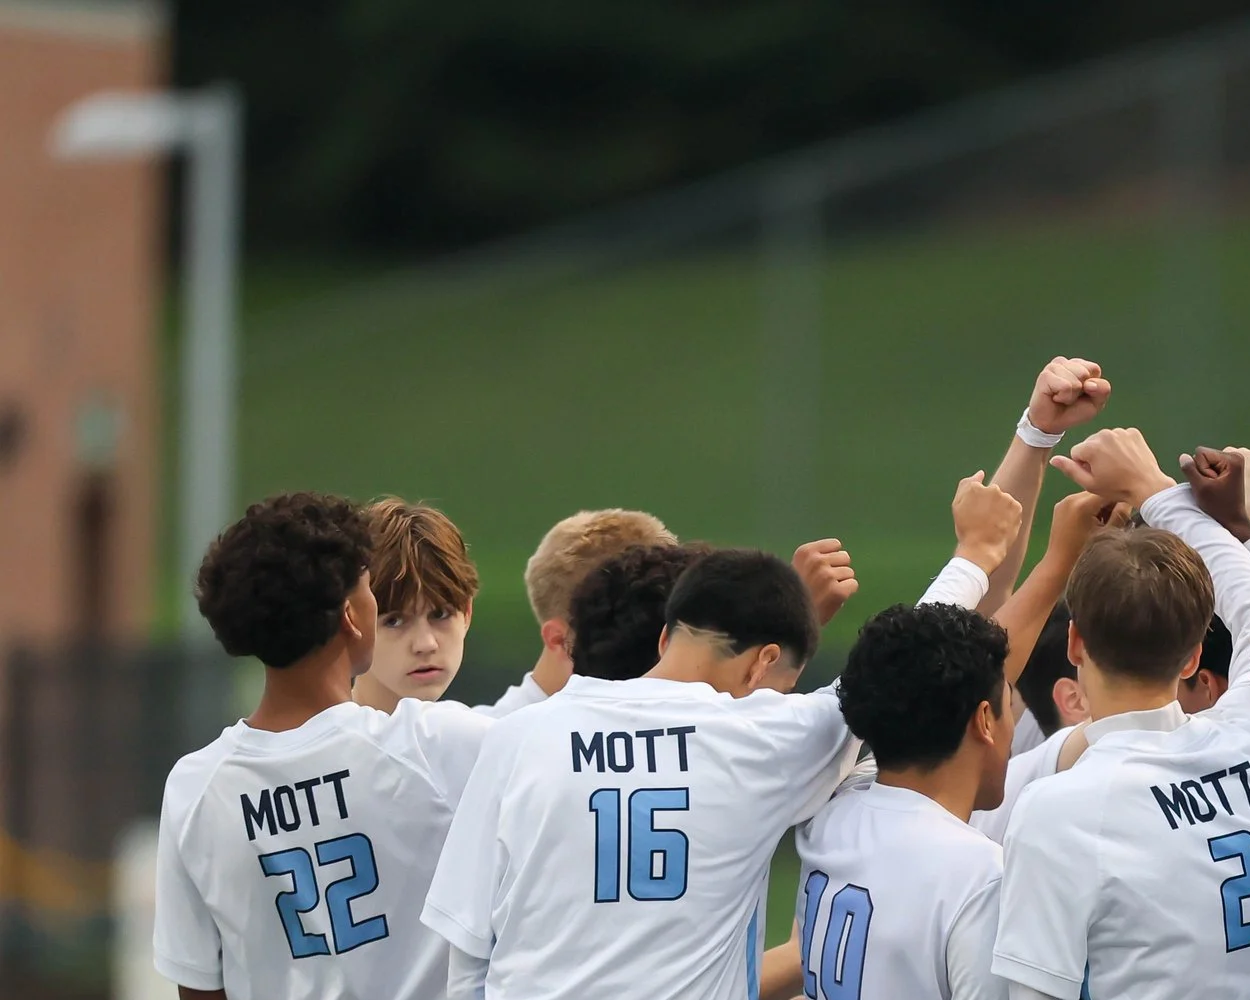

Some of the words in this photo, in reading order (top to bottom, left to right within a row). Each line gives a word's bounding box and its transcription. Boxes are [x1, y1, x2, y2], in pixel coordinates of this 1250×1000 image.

[570, 726, 696, 773] MOTT
[240, 769, 350, 840] MOTT
[589, 787, 690, 904] 16
[258, 832, 390, 959] 22
